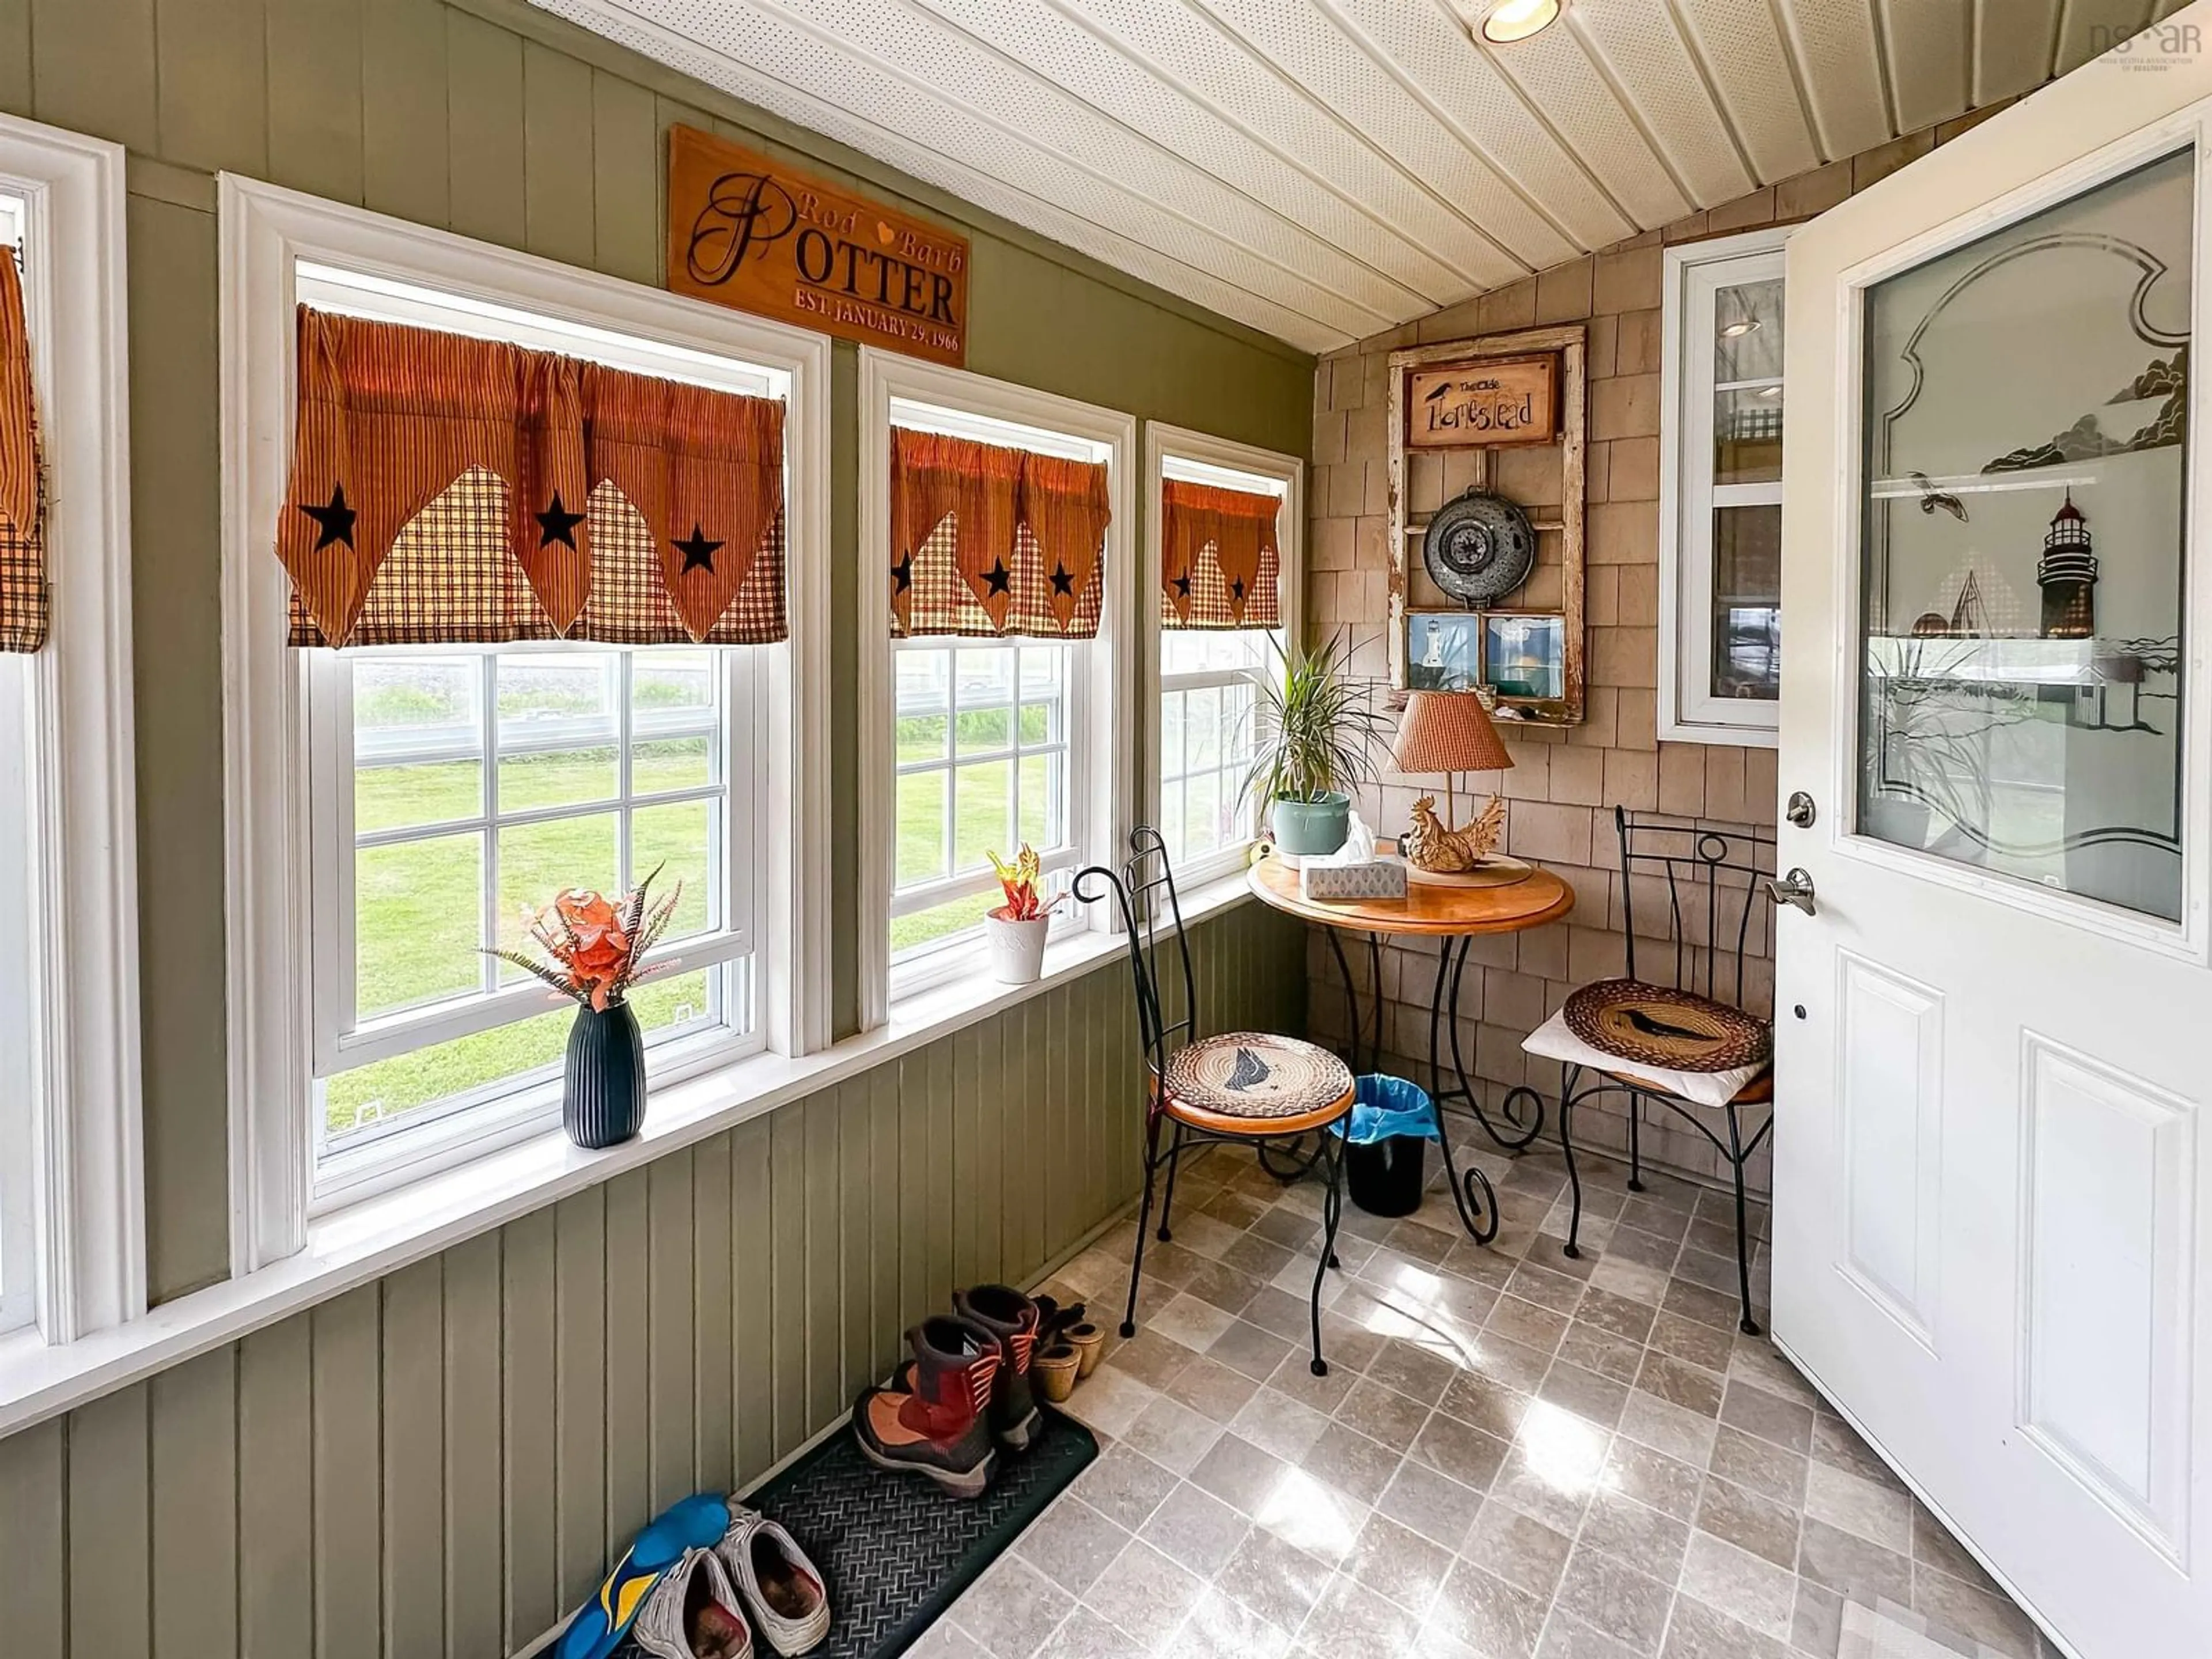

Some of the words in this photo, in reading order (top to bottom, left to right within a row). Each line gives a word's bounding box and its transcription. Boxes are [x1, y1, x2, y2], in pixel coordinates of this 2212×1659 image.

[798, 191, 864, 235] Rod
[897, 232, 962, 273] Barb
[795, 289, 831, 316] EST.
[834, 301, 910, 338] JANUARY
[911, 324, 929, 345] 29,
[932, 332, 959, 352] 1966
